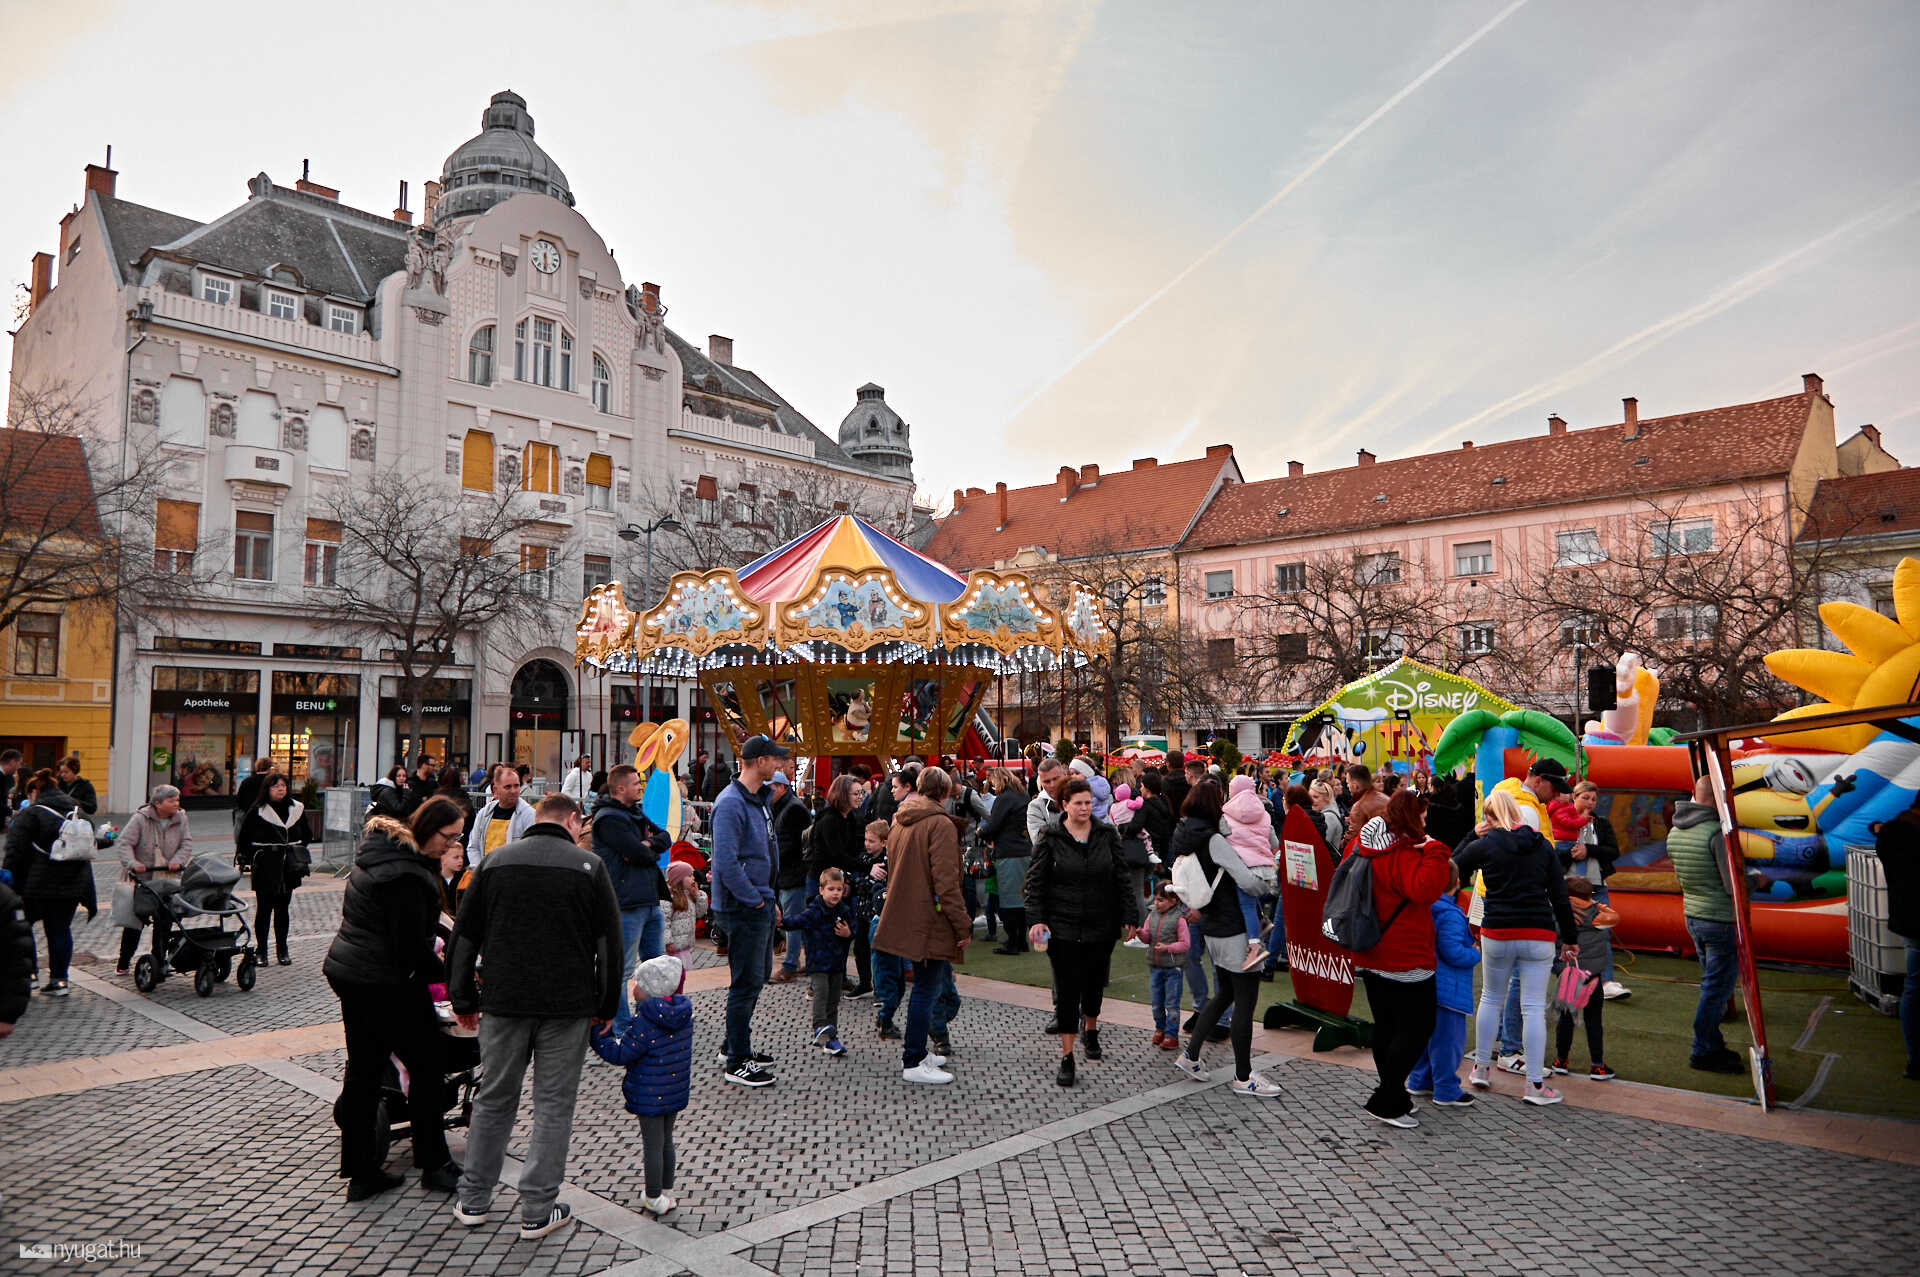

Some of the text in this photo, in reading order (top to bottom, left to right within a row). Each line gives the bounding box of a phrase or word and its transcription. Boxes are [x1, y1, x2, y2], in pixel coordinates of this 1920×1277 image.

[183, 698, 230, 708] Apotheke
[295, 701, 326, 710] BENU
[400, 704, 452, 713] Gyyszertár
